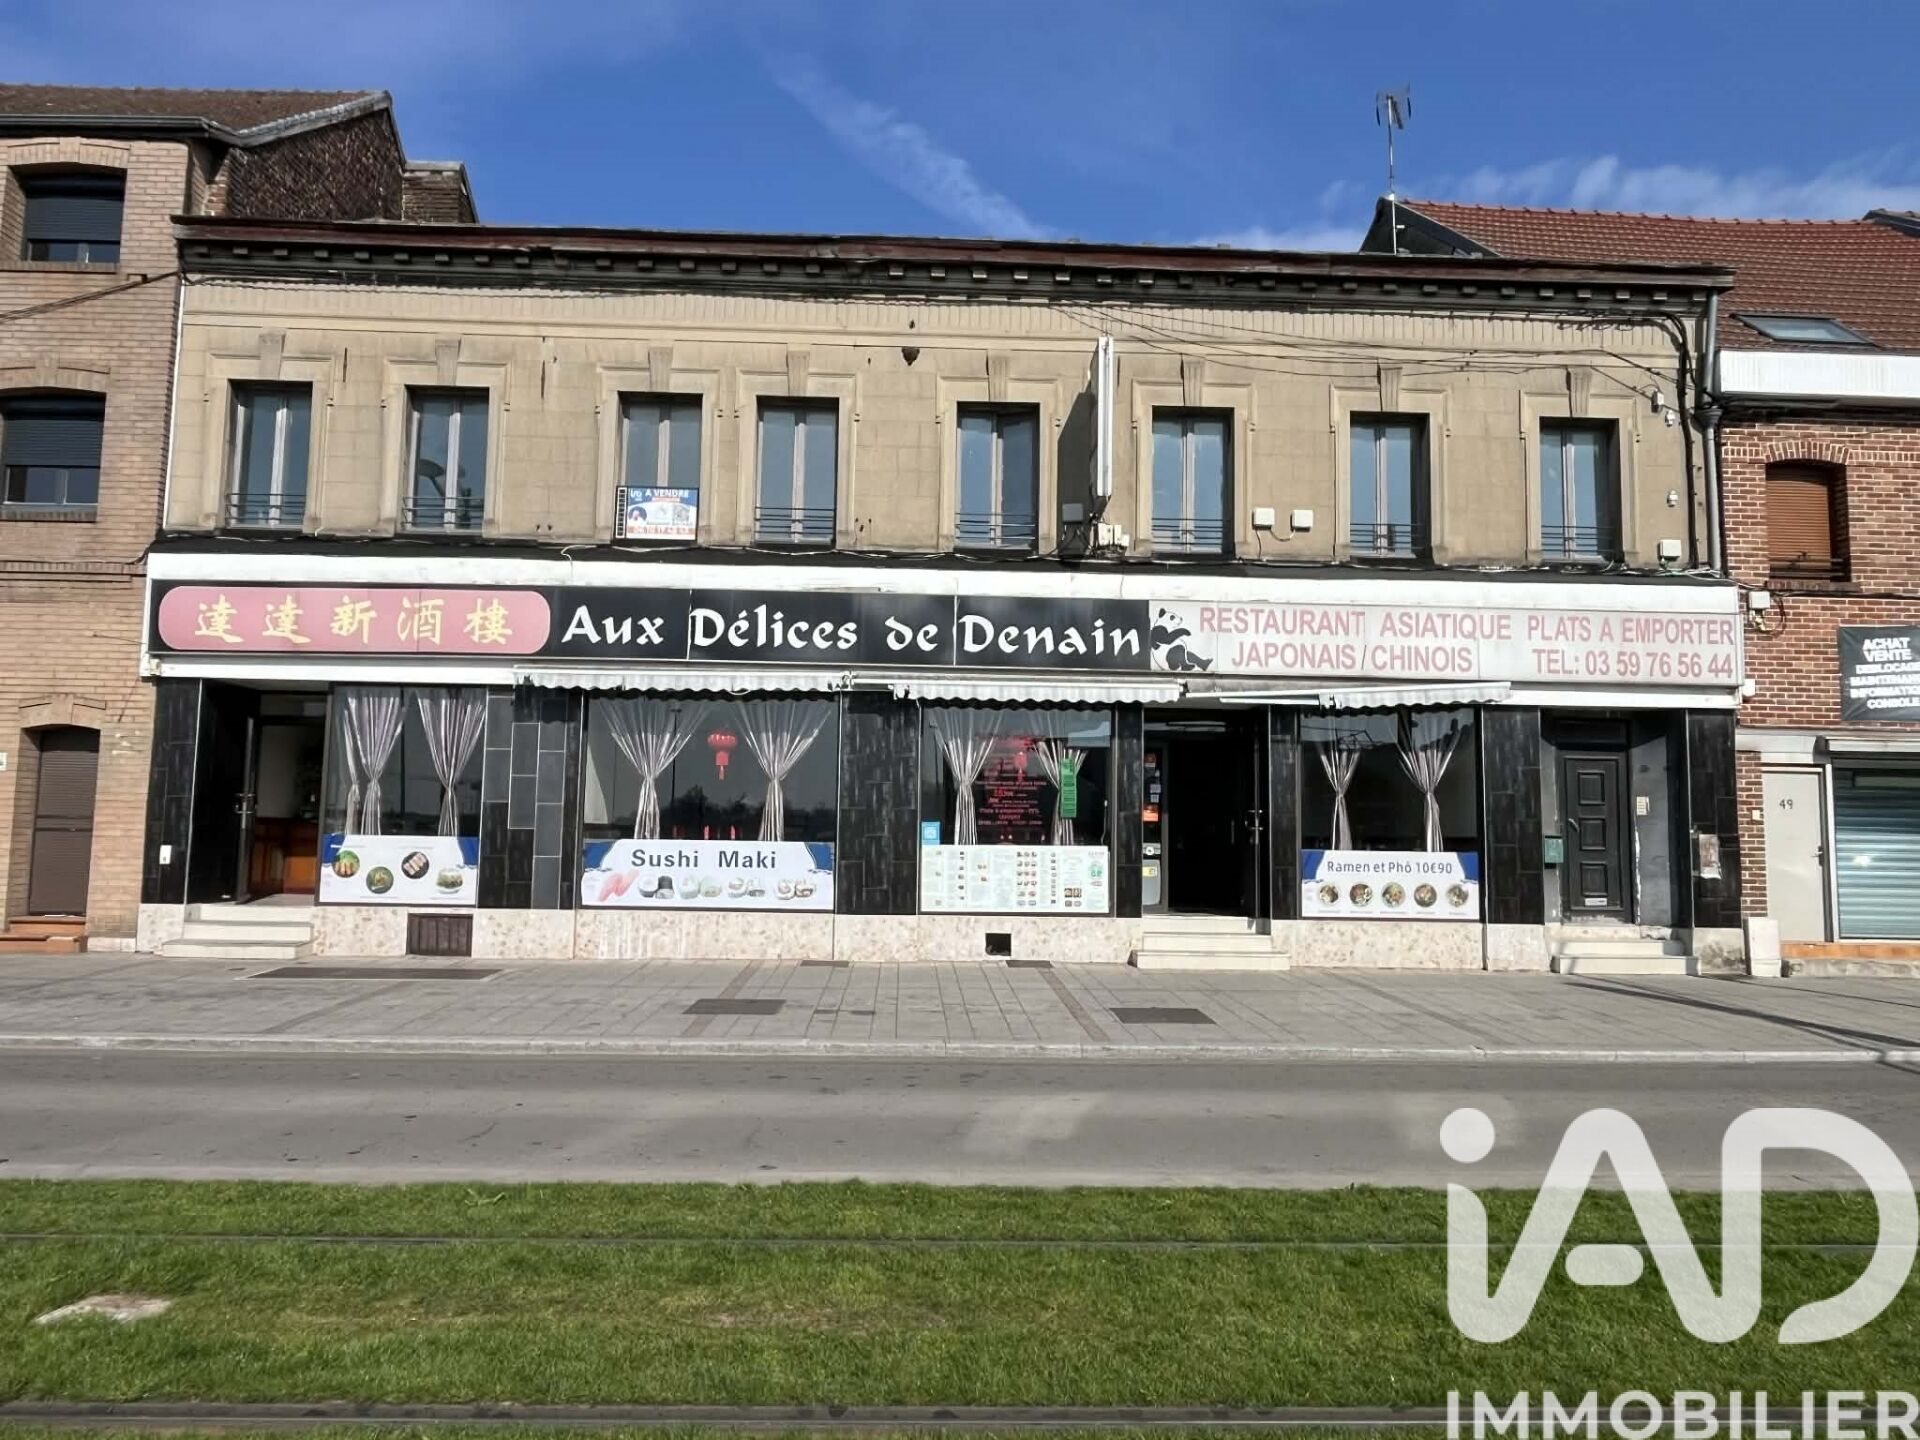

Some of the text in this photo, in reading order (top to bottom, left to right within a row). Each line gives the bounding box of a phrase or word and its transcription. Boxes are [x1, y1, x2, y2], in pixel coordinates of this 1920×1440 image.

[194, 594, 514, 646] 達達新酒樓
[561, 603, 1141, 656] Aux Délices de Denain
[1199, 607, 1735, 646] RESTAURANT ASIATIQUE PLATS A EMPORTER
[1863, 637, 1910, 650] ACHAT
[1532, 649, 1734, 680] TEL: 03 59 76 56 44
[1863, 649, 1912, 662] VENTE
[1779, 799, 1794, 810] 49
[631, 849, 776, 869] Sushi Maki
[1327, 861, 1370, 873] Ramen
[1373, 862, 1385, 873] et
[1416, 862, 1452, 874] 10€90
